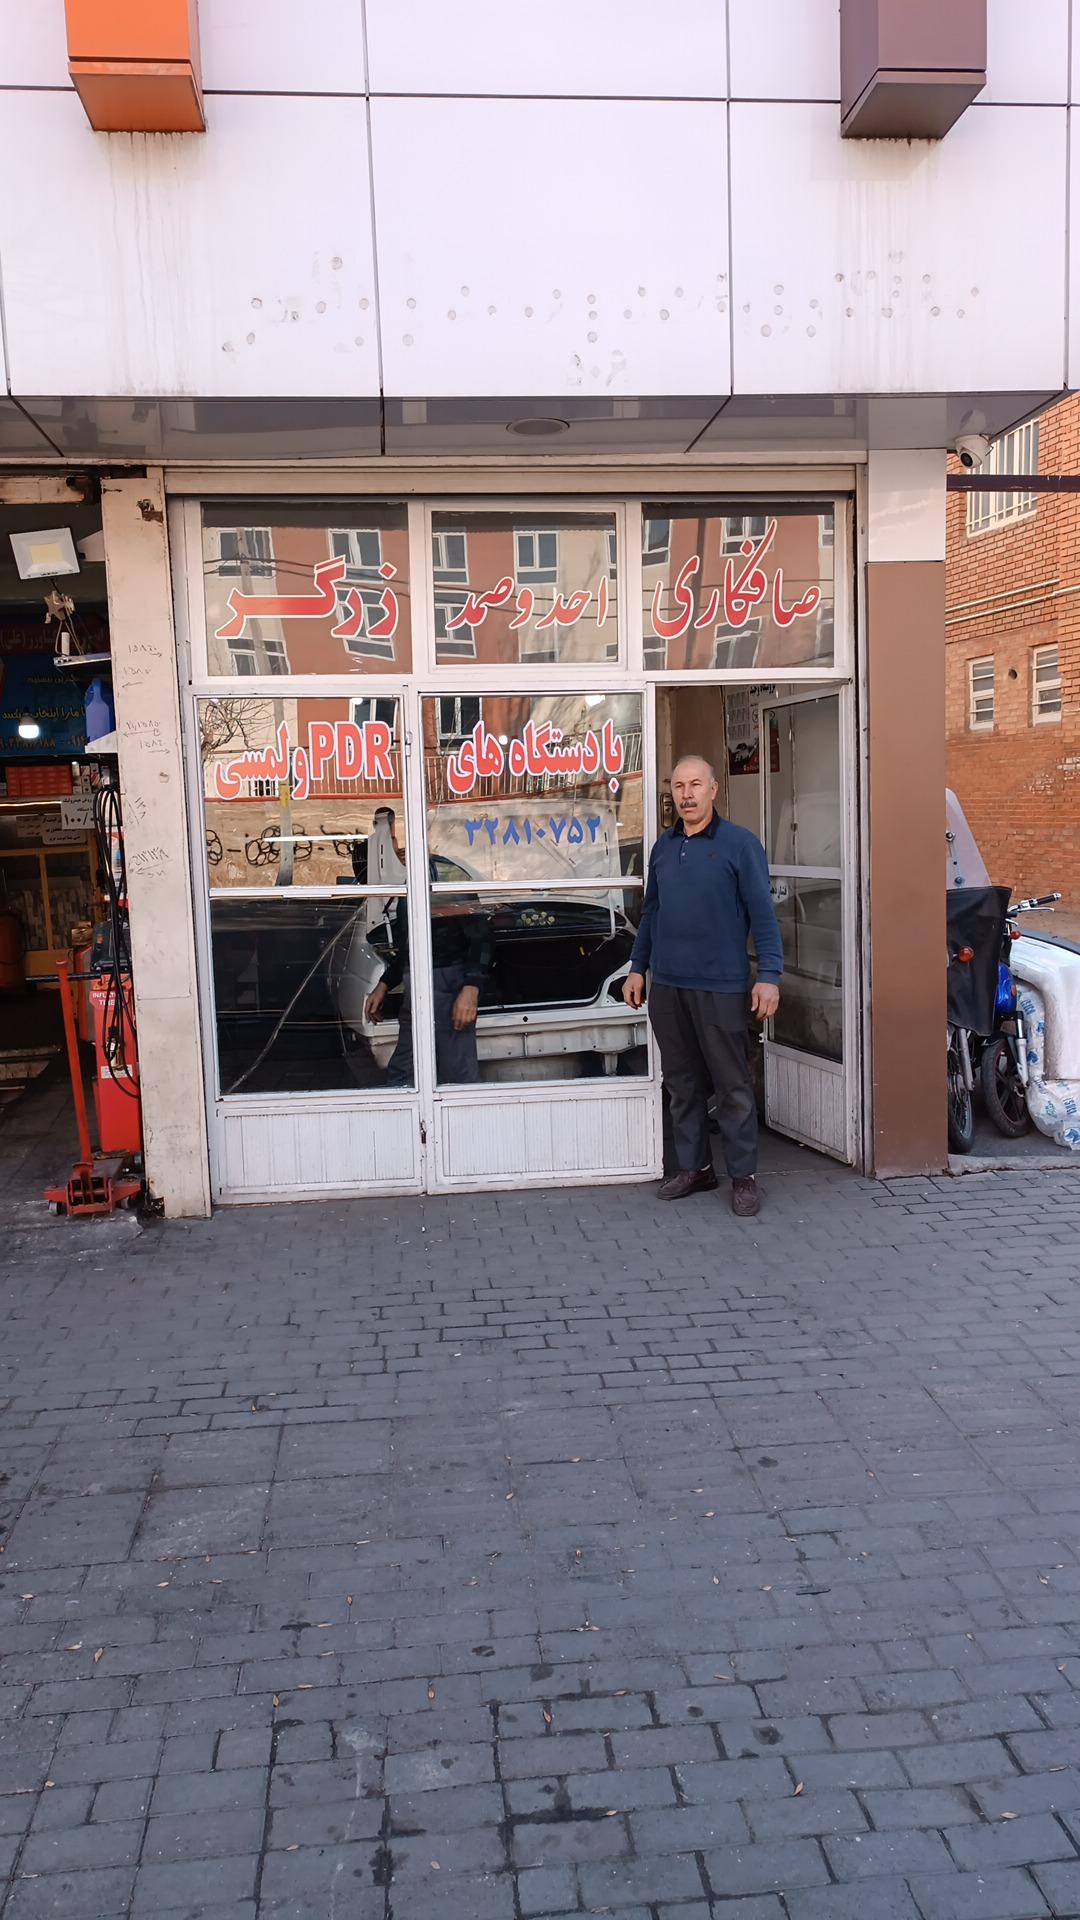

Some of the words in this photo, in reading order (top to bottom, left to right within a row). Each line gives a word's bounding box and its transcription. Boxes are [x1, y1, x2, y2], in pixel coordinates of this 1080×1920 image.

[215, 554, 399, 639] زرگر
[444, 576, 515, 631] صمد
[535, 575, 609, 630] احد
[651, 519, 822, 639] صافکاری
[215, 720, 291, 800] لمسی
[308, 721, 396, 780] PDR
[464, 815, 600, 846] ۳۲۸۱۰۷۵۲
